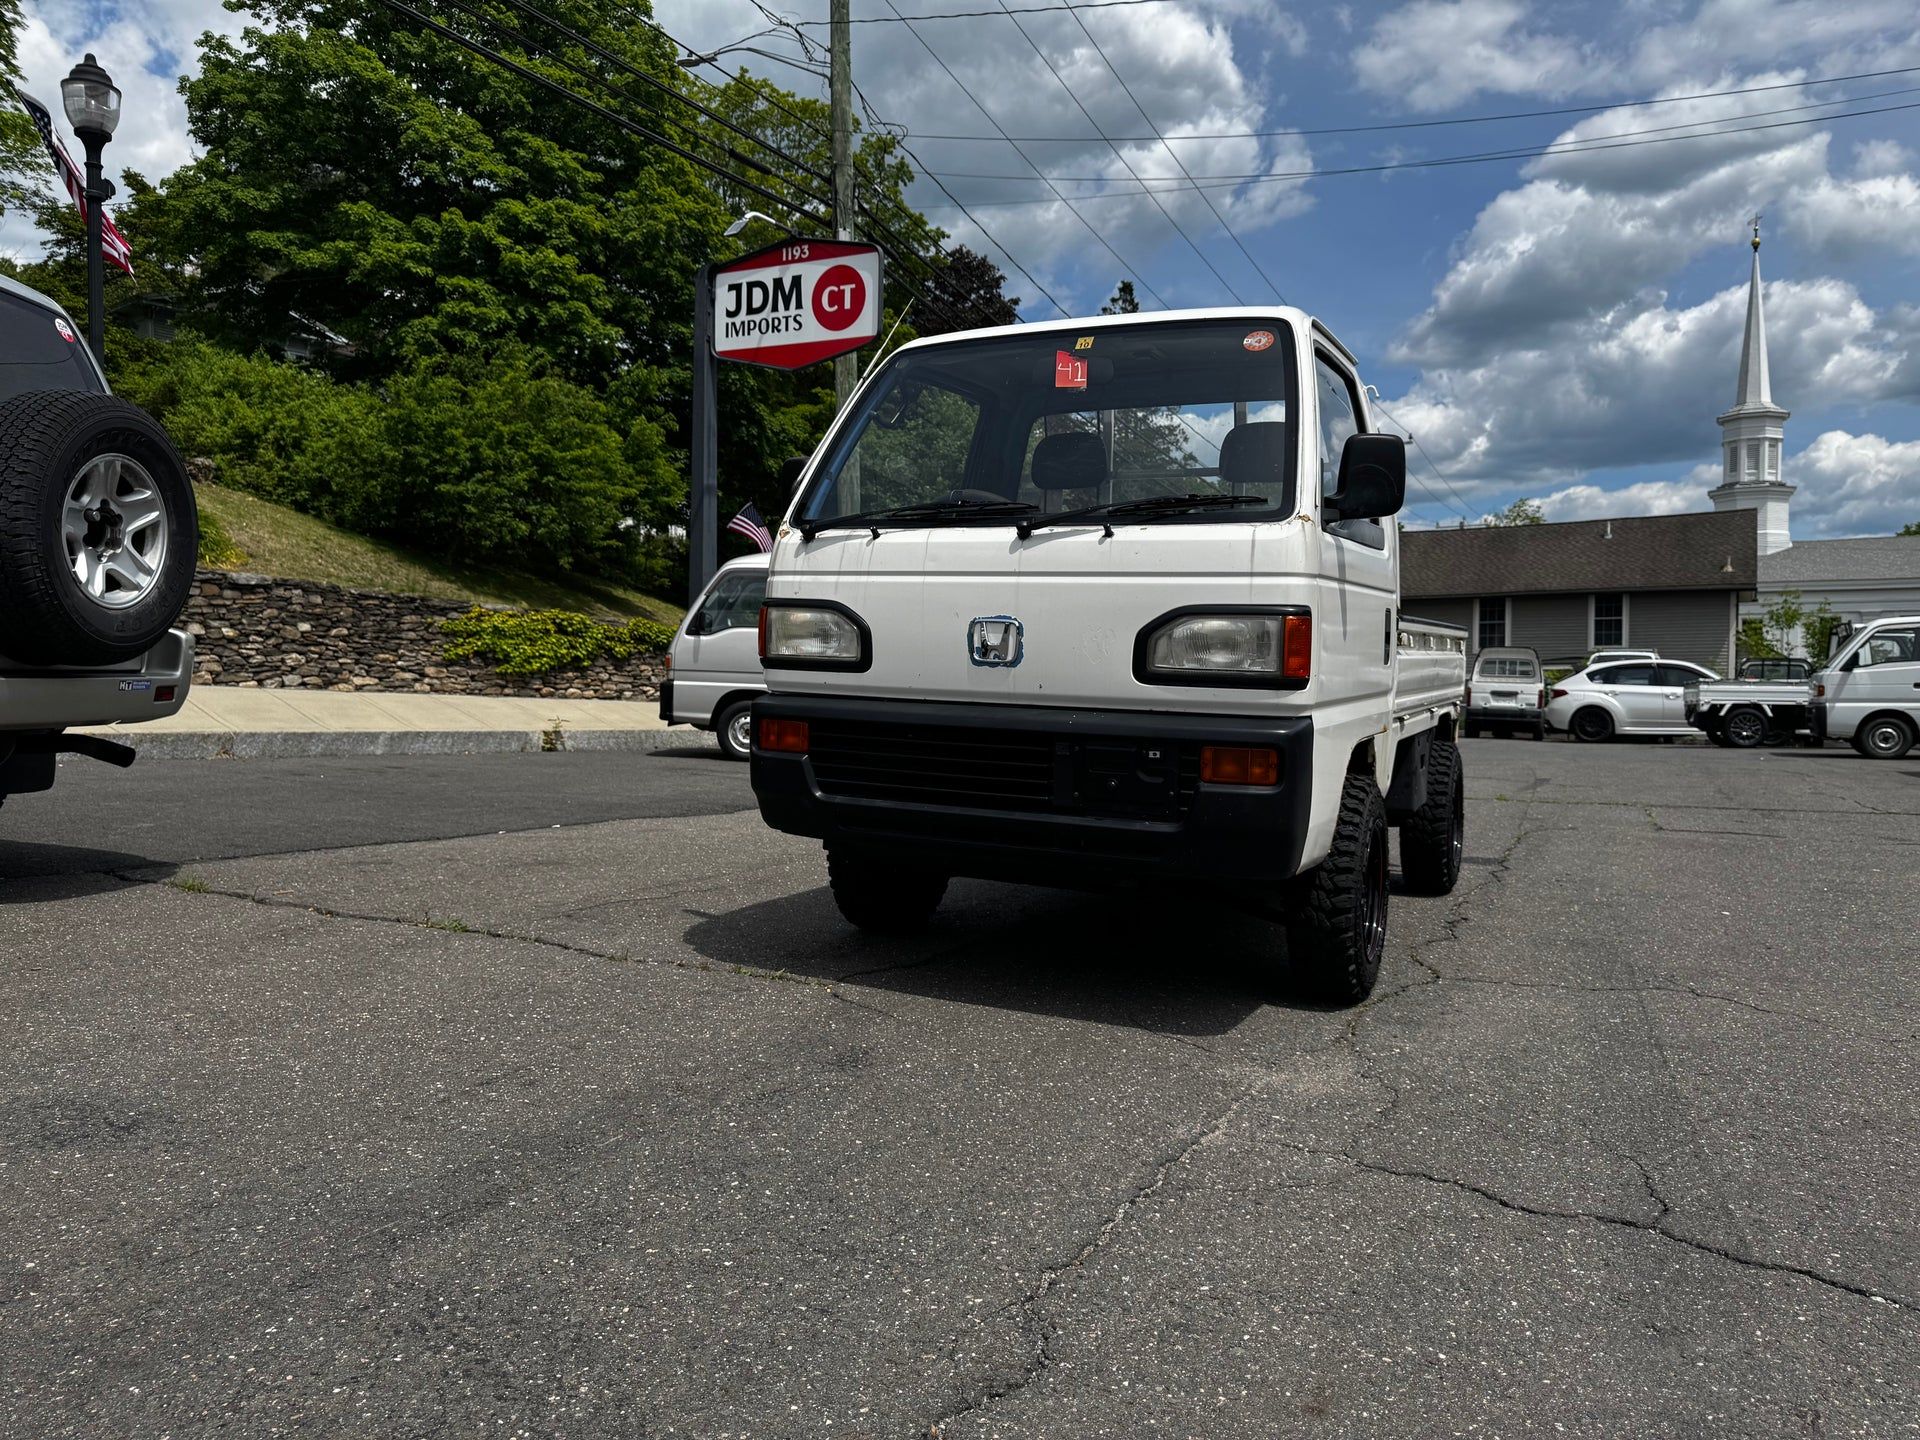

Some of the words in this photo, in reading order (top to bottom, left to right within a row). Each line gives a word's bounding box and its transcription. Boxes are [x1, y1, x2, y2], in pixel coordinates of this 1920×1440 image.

[782, 244, 810, 262] 1193
[725, 274, 804, 319] JDM
[821, 283, 856, 312] CT
[725, 314, 803, 338] IMPORTS
[1058, 362, 1086, 381] 41
